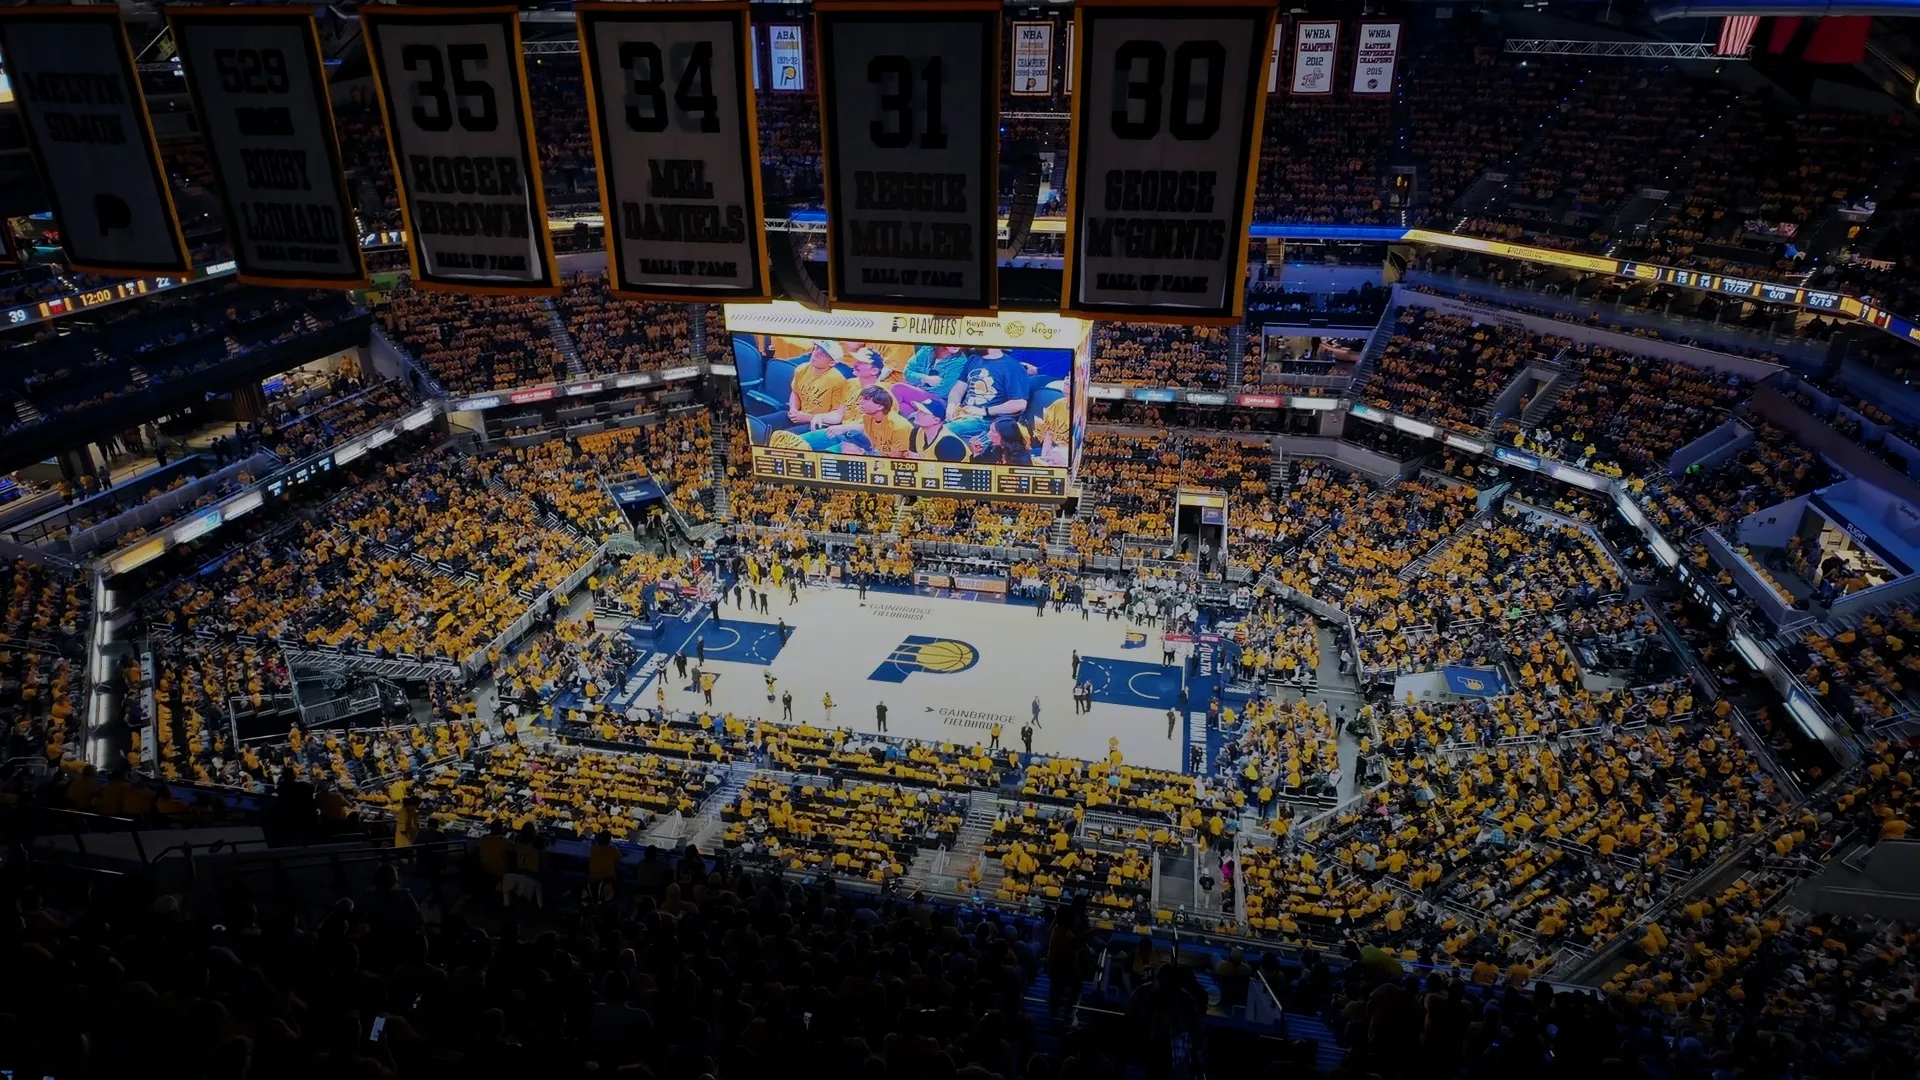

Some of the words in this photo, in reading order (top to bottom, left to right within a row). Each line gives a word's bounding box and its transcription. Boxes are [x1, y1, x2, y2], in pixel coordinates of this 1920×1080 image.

[776, 31, 796, 40] ABA
[1023, 31, 1043, 40] NBA
[1304, 29, 1331, 39] WNBA
[1368, 29, 1391, 38] WNBA
[1300, 42, 1334, 52] CHAMPIONS
[1305, 56, 1324, 66] 2012
[213, 49, 289, 93] 529
[1366, 67, 1383, 76] 2015
[402, 43, 498, 132] 35
[618, 41, 721, 133] 34
[1111, 40, 1227, 141] 30
[867, 55, 947, 149] 31
[409, 154, 523, 196] ROGER
[648, 158, 714, 199] MEL
[854, 170, 967, 213] REGGIE
[1105, 170, 1218, 213] GEORGE
[240, 202, 340, 246] LEONARD
[416, 200, 529, 239] BROWN
[622, 202, 744, 244] DANIELS
[848, 219, 973, 261] MILLER
[435, 252, 471, 269] HALL
[472, 254, 488, 269] OF
[490, 254, 526, 271] FAME
[640, 259, 677, 275] HALL
[679, 260, 696, 276] OF
[698, 261, 738, 278] FAME
[155, 277, 170, 289] 22
[861, 267, 899, 285] HALL
[900, 269, 918, 285] OF
[920, 270, 964, 287] FAME
[1096, 273, 1137, 291] HALL
[1139, 275, 1158, 292] OF
[1160, 275, 1208, 293] FAME
[1677, 276, 1687, 284] 15
[1700, 280, 1710, 288] 14
[128, 287, 135, 296] 2
[1724, 283, 1750, 294] 17/27
[1769, 291, 1786, 299] 0/0
[79, 289, 112, 307] 12:00
[1810, 297, 1833, 307] 5/13
[8, 309, 26, 323] 39
[966, 319, 1001, 329] KeyBank
[909, 317, 957, 336] PLAYOFFS
[1031, 322, 1061, 339] Kroger
[893, 462, 916, 471] 12:00
[873, 475, 885, 484] 39
[925, 479, 936, 488] 22
[1846, 523, 1868, 543] FLIGHT
[869, 603, 934, 615] GAINBRIDGE
[1200, 652, 1212, 676] ULTRA
[939, 707, 1016, 724] GAINBRIDGE
